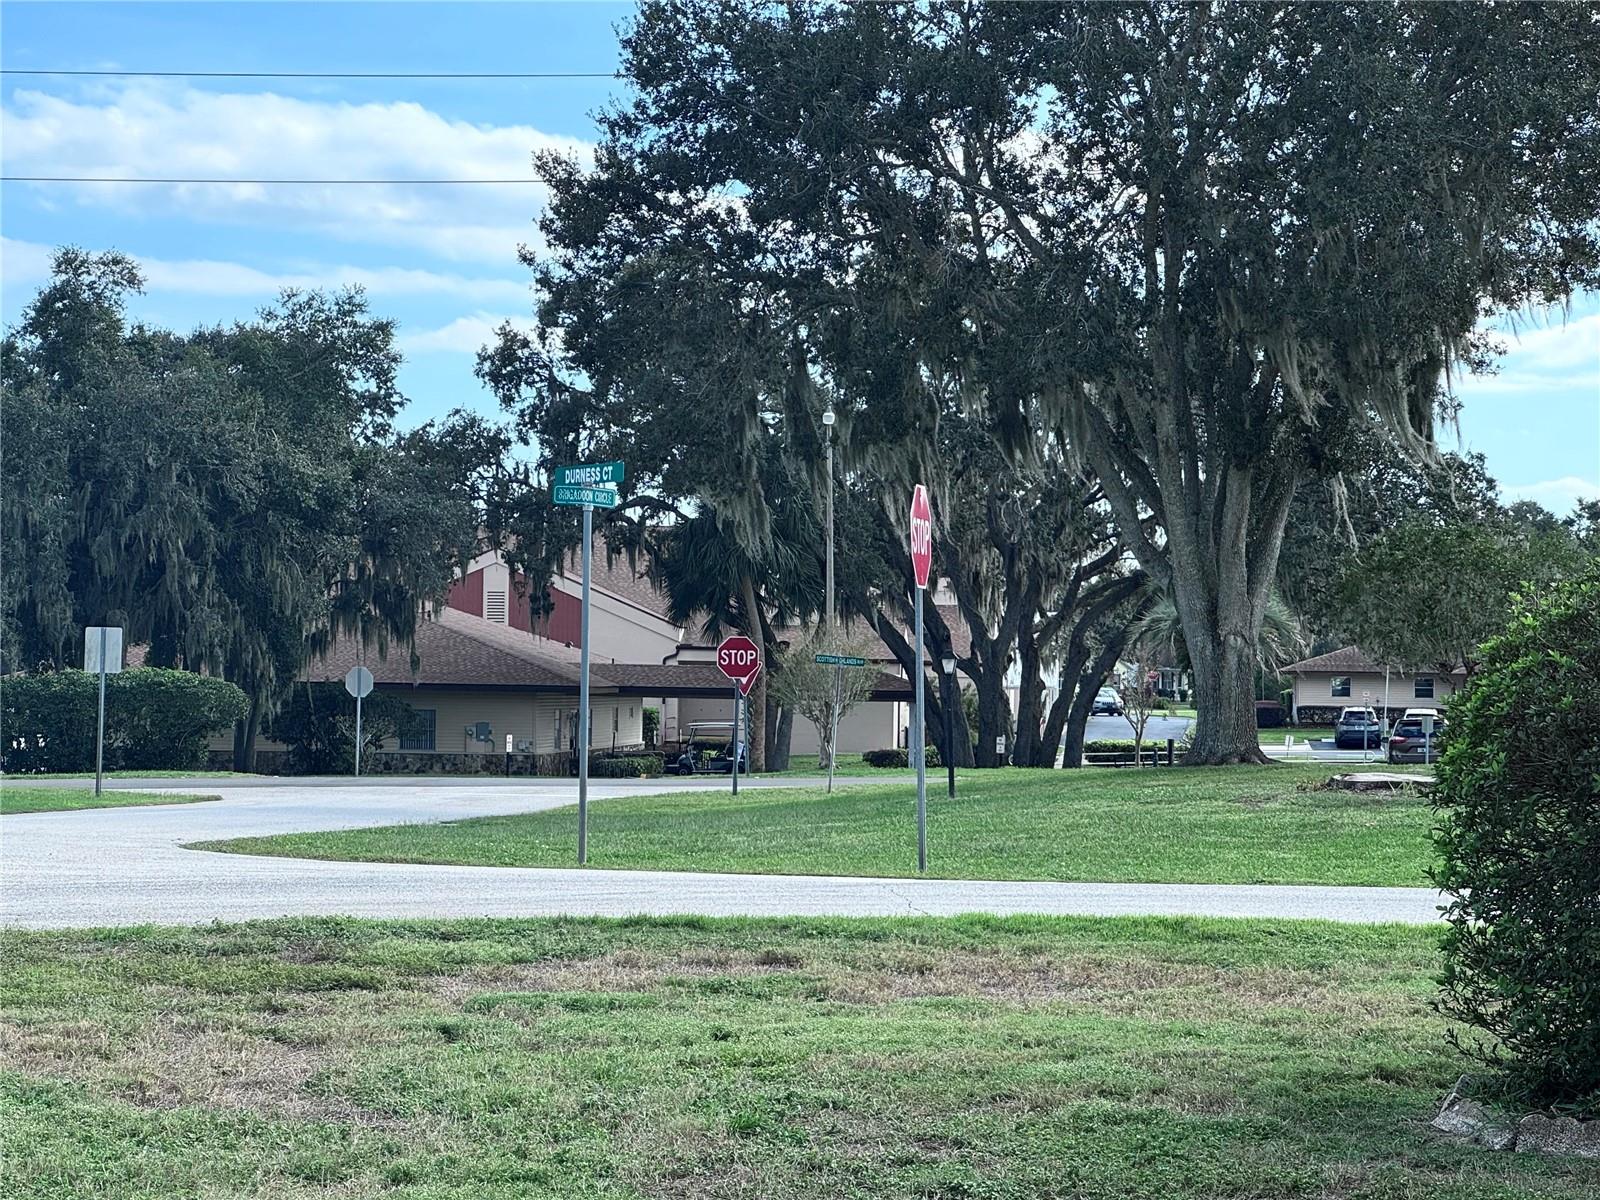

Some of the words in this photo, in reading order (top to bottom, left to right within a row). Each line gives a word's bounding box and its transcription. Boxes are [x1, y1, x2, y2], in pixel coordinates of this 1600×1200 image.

[565, 467, 600, 484] DURNESS
[602, 465, 613, 481] CT
[912, 517, 930, 556] STOP
[720, 649, 757, 666] STOP
